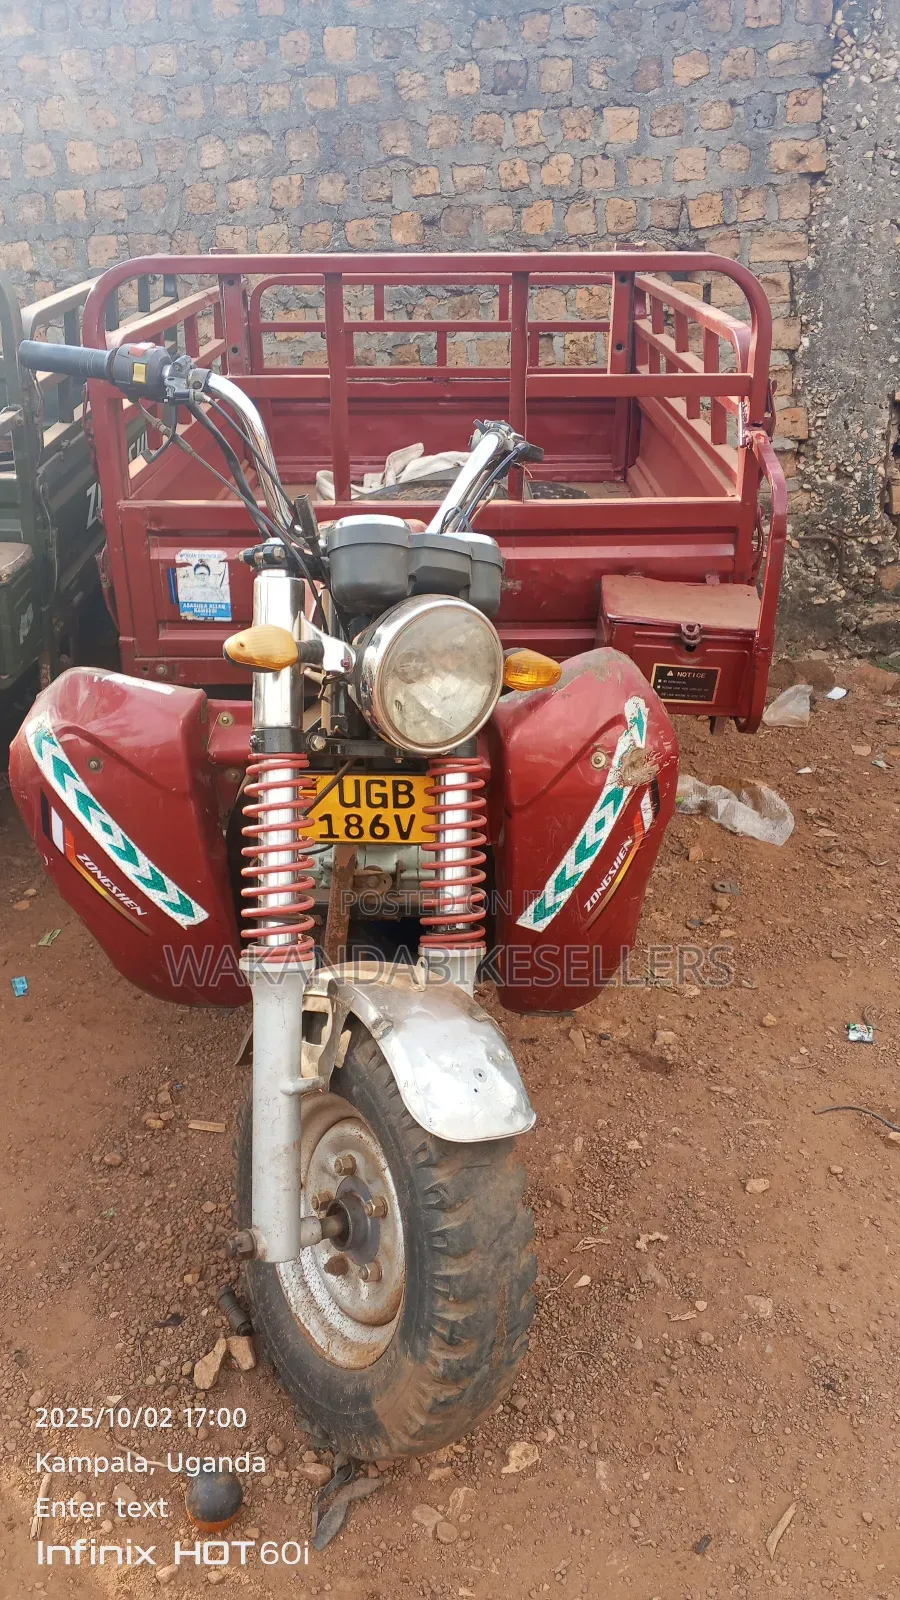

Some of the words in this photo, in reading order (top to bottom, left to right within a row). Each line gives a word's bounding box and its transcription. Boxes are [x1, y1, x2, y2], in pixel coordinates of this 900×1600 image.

[677, 671, 706, 679] NOTICE
[338, 779, 416, 809] UGB
[318, 813, 416, 840] 186V
[76, 853, 148, 916] ZONGSHEN
[583, 835, 634, 912] ZONGSHEN
